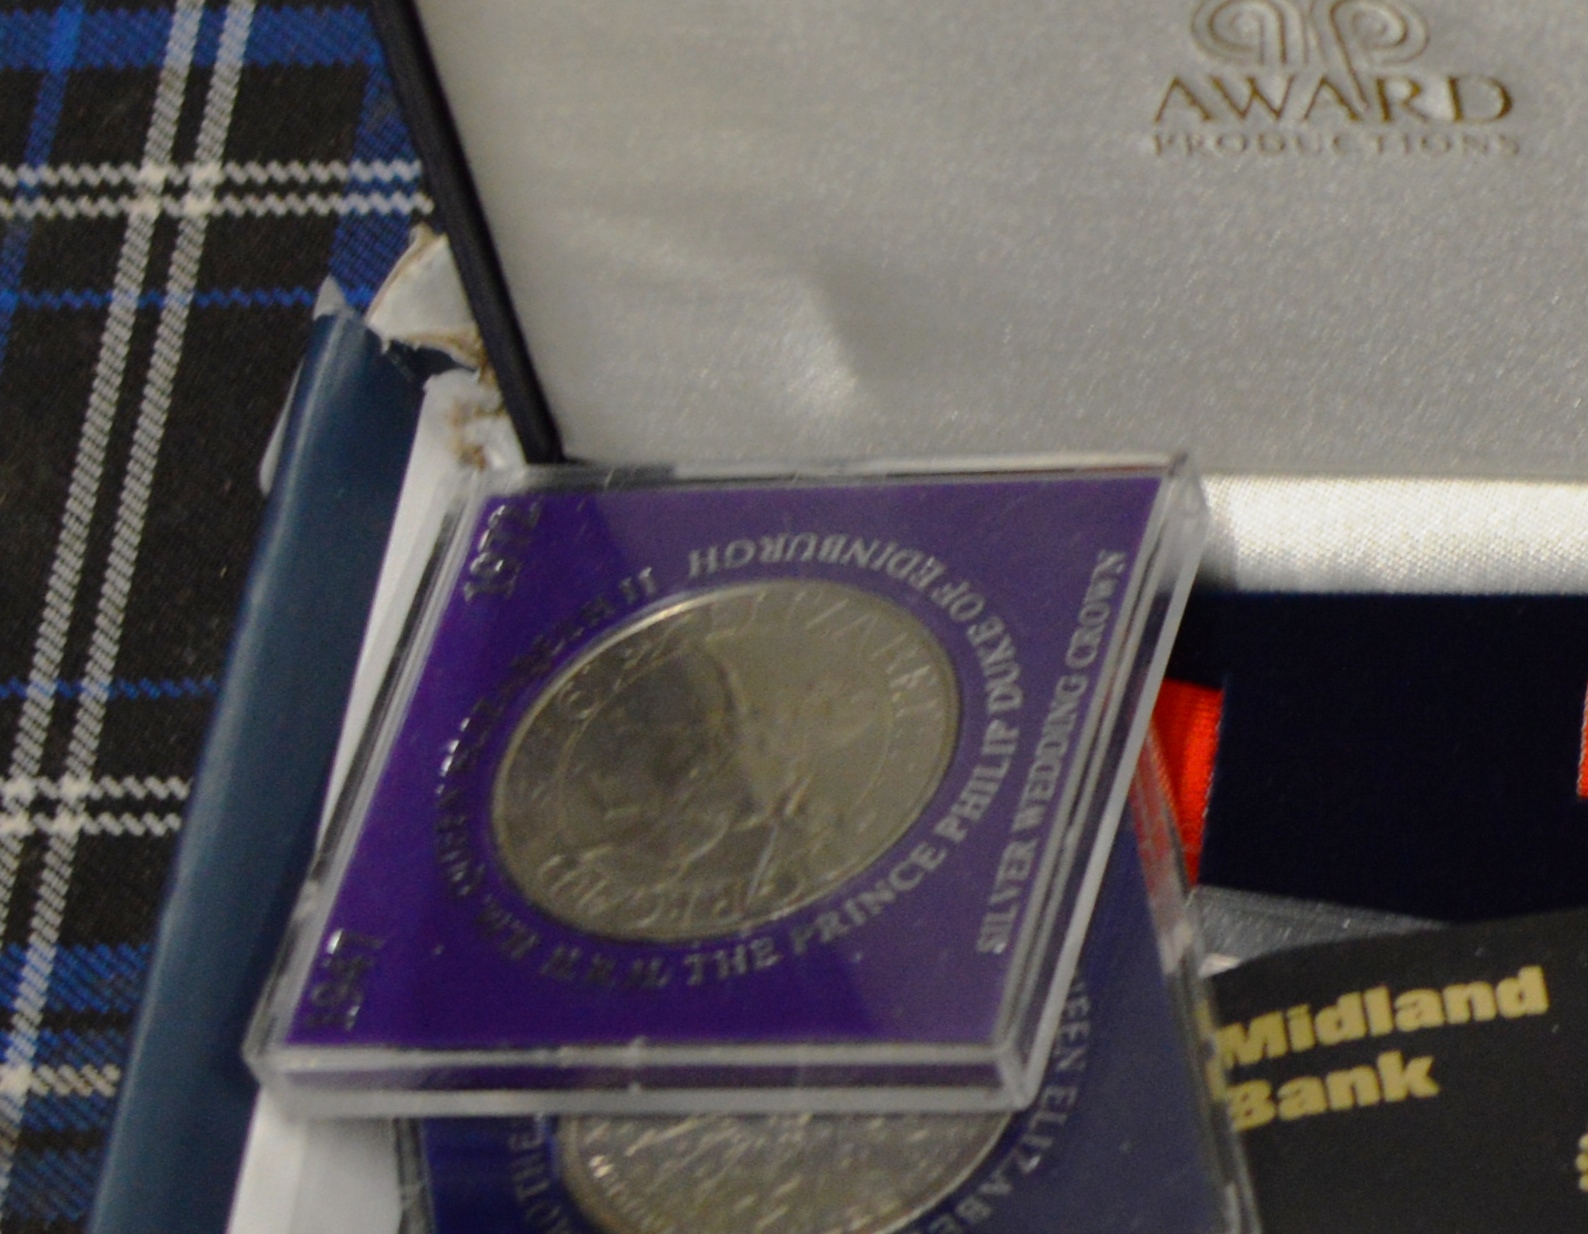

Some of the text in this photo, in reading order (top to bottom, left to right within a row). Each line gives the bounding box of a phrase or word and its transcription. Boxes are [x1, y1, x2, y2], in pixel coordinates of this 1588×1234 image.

[1153, 74, 1514, 125] AWARD
[1153, 132, 1522, 158] PRODUCTIONS
[686, 530, 948, 593] EDINBURGH
[930, 579, 986, 622] OF
[966, 616, 1025, 714] DUKE
[934, 718, 1021, 844] PHILIP
[976, 548, 1126, 955] SILVER WEDDING CROWN
[789, 840, 948, 955] PRINCE
[683, 936, 783, 986] THE
[1215, 964, 1549, 1068] Midland
[1226, 1049, 1440, 1133] Bank
